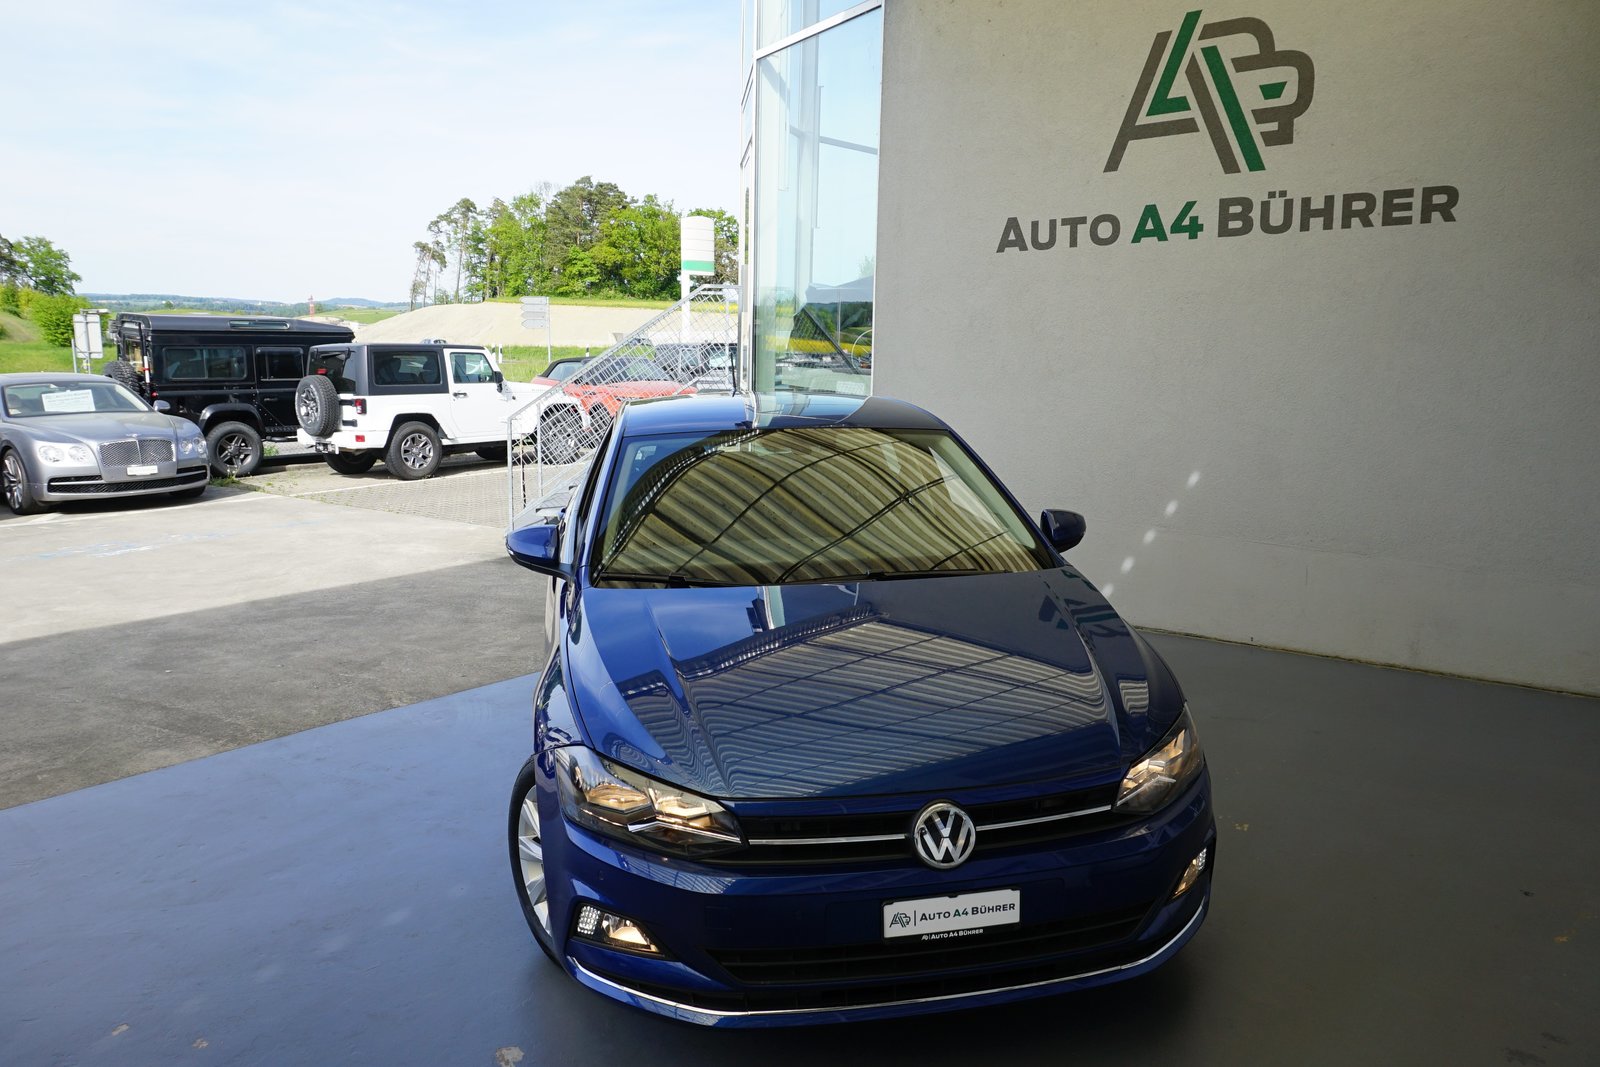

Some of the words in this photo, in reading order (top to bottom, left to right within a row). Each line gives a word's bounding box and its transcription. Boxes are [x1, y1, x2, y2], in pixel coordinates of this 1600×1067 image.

[996, 213, 1121, 253] AUTO
[1131, 200, 1204, 244] A4
[1217, 185, 1460, 238] BÜHRER
[919, 911, 951, 922] AUTO
[953, 908, 969, 917] A4
[971, 903, 1016, 915] BÜHRER
[958, 928, 984, 936] BÜHRER
